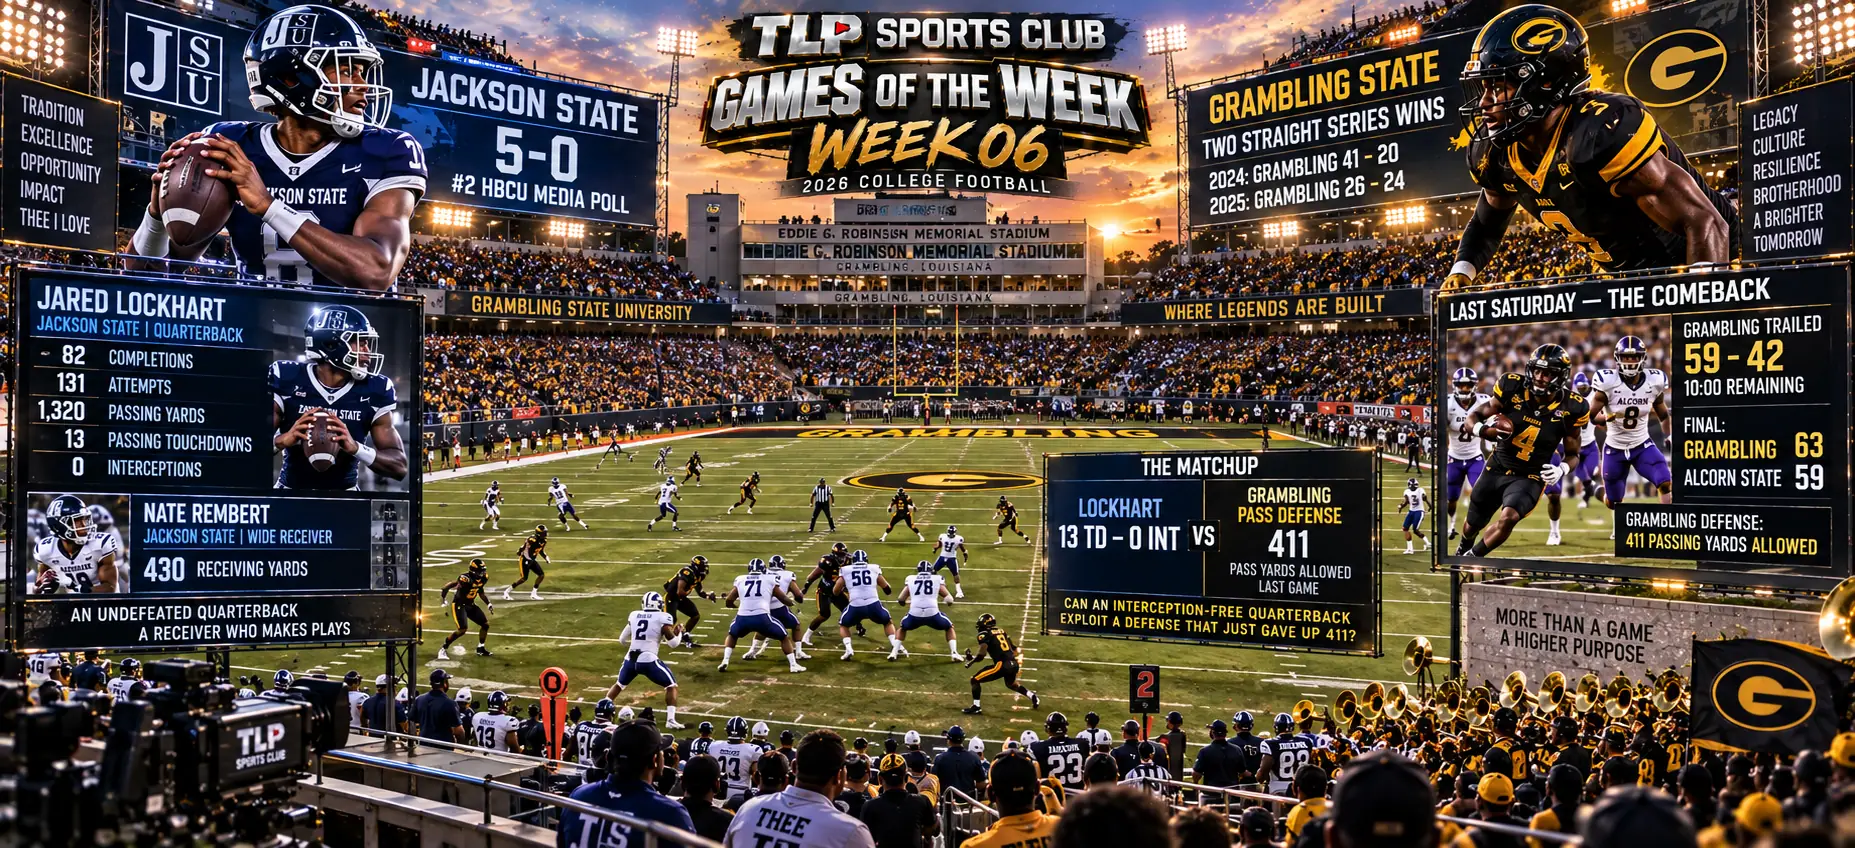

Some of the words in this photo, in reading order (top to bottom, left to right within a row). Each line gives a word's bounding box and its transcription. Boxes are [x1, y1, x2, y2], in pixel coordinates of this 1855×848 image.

[1209, 68, 1350, 124] GRAMBLING
[1359, 49, 1440, 96] STATE
[21, 94, 84, 128] TRADITION
[411, 68, 545, 118] JACKSON
[556, 93, 638, 134] STATE
[1202, 134, 1236, 160] TWO
[1242, 118, 1322, 153] STRAIGHT
[1327, 107, 1389, 139] SERIES
[1395, 96, 1445, 126] WINS
[1753, 104, 1799, 132] LEGACY
[21, 123, 93, 156] EXCELLENCE
[1753, 129, 1806, 156] CULTURE
[496, 125, 578, 182] 5-0
[1209, 167, 1249, 190] 2024:
[1253, 152, 1337, 184] GRAMBLING
[1342, 148, 1359, 169] 41
[1378, 142, 1398, 164] 20
[1753, 151, 1821, 180] RESILIENCE
[21, 151, 101, 185] OPPORTUNITY
[21, 181, 64, 205] IMPACT
[452, 174, 475, 194] #2
[482, 177, 527, 200] HBCU
[534, 185, 584, 209] MEDIA
[591, 191, 629, 214] POLL
[1209, 192, 1250, 215] 2025:
[1254, 178, 1339, 210] GRAMBLING
[1344, 175, 1364, 197] 26
[1384, 170, 1404, 192] 24
[1753, 174, 1842, 205] BROTHERHOOD
[20, 207, 50, 229] THEE
[61, 212, 90, 235] LOVE
[1765, 204, 1824, 228] BRIGHTER
[778, 228, 818, 239] EDDIE
[914, 228, 984, 238] MEMORIAL
[990, 228, 1050, 238] STADIUM
[1754, 227, 1824, 253] TOMORROW
[37, 285, 108, 314] JARED
[116, 294, 226, 321] LOCKHART
[472, 296, 562, 316] GRAMBLING
[568, 301, 610, 318] STATE
[615, 302, 693, 321] UNIVERSITY
[1164, 303, 1212, 320] WHERE
[1219, 300, 1288, 319] LEGENDS
[1295, 298, 1328, 316] ARE
[1336, 294, 1385, 314] BUILT
[1450, 300, 1486, 322] LAST
[1491, 292, 1576, 318] SATURDAY
[1608, 288, 1644, 310] THE
[1652, 278, 1771, 306] COMEBACK
[36, 316, 98, 334] JACKSON
[102, 319, 139, 336] STATE
[154, 324, 243, 342] QUARTERBACK
[1684, 318, 1760, 338] GRAMBLING
[1764, 315, 1822, 334] TRAILED
[62, 344, 86, 365] 82
[108, 348, 194, 369] COMPLETIONS
[1684, 342, 1720, 374] 59
[1746, 340, 1784, 372] 42
[57, 372, 85, 392] 131
[108, 377, 172, 395] ATTEMPTS
[1684, 379, 1722, 397] 10:00
[1726, 376, 1804, 395] REMAINING
[38, 400, 85, 422] 1,320
[108, 404, 161, 422] PASSING
[165, 406, 205, 424] YARDS
[797, 428, 1160, 438] GRAMBLING
[1684, 417, 1725, 434] FINAL:
[65, 429, 84, 448] 13
[108, 432, 162, 450] PASSING
[166, 434, 252, 452] TOUCHDOWNS
[1684, 439, 1776, 460] GRAMBLING
[1794, 432, 1824, 458] 63
[72, 457, 84, 476] 0
[108, 459, 202, 478] INTERCEPTIONS
[1141, 458, 1171, 476] THE
[1177, 456, 1258, 475] MATCHUP
[1684, 469, 1736, 486] ALCORN
[1740, 469, 1782, 486] STATE
[1794, 464, 1824, 492] 59
[1078, 498, 1162, 518] LOCKHART
[1248, 488, 1331, 504] GRAMBLING
[144, 503, 186, 524] NATE
[192, 504, 270, 524] REMBERT
[1238, 507, 1273, 524] PASS
[1278, 508, 1342, 524] DEFENSE
[1626, 512, 1696, 529] GRAMBLING
[1701, 514, 1764, 531] DEFENSE:
[144, 529, 197, 544] JACKSON
[201, 529, 235, 544] STATE
[247, 529, 278, 544] WIDE
[280, 530, 332, 544] RECEIVER
[1059, 525, 1078, 548] 13
[1084, 526, 1106, 549] TD
[1130, 526, 1141, 550] 0
[1148, 526, 1180, 550] INT
[1193, 526, 1215, 546] VS
[1268, 530, 1308, 558] 411
[1626, 532, 1644, 548] 411
[1648, 533, 1701, 550] PASSING
[1705, 535, 1748, 552] YARDS
[1751, 536, 1818, 555] ALLOWED
[144, 557, 185, 582] 430
[197, 560, 264, 578] RECEIVING
[268, 561, 308, 577] YARDS
[851, 570, 872, 586] 56
[1230, 563, 1258, 576] PASS
[1261, 564, 1296, 578] YARDS
[1300, 565, 1352, 579] ALLOWED
[744, 580, 762, 597] 71
[914, 580, 933, 595] 78
[1258, 580, 1284, 594] LAST
[1289, 581, 1319, 595] GAME
[71, 607, 92, 622] AN
[98, 605, 192, 621] UNDEFEATED
[197, 603, 298, 620] QUARTERBACK
[1064, 597, 1088, 610] CAN
[1092, 599, 1108, 611] AN
[1113, 600, 1243, 618] INTERCEPTION-FREE
[1248, 607, 1350, 624] QUARTERBACK
[154, 624, 221, 640] RECEIVER
[225, 624, 258, 639] WHO
[262, 623, 307, 638] MAKES
[312, 621, 351, 637] PLAYS
[1060, 613, 1108, 626] EXPLOIT
[1126, 616, 1180, 631] DEFENSE
[1185, 620, 1218, 633] THAT
[1223, 622, 1256, 636] JUST
[1261, 624, 1296, 638] GAVE
[1302, 627, 1319, 640] UP
[1326, 628, 1356, 642] 411?
[1496, 607, 1538, 628] MORE
[1543, 612, 1584, 635] THAN
[1606, 620, 1654, 643] GAME
[1514, 631, 1568, 654] HIGHER
[1573, 638, 1646, 664] PURPOSE
[1137, 670, 1154, 698] 2
[236, 722, 285, 755] TLP
[756, 808, 812, 838] THEE
